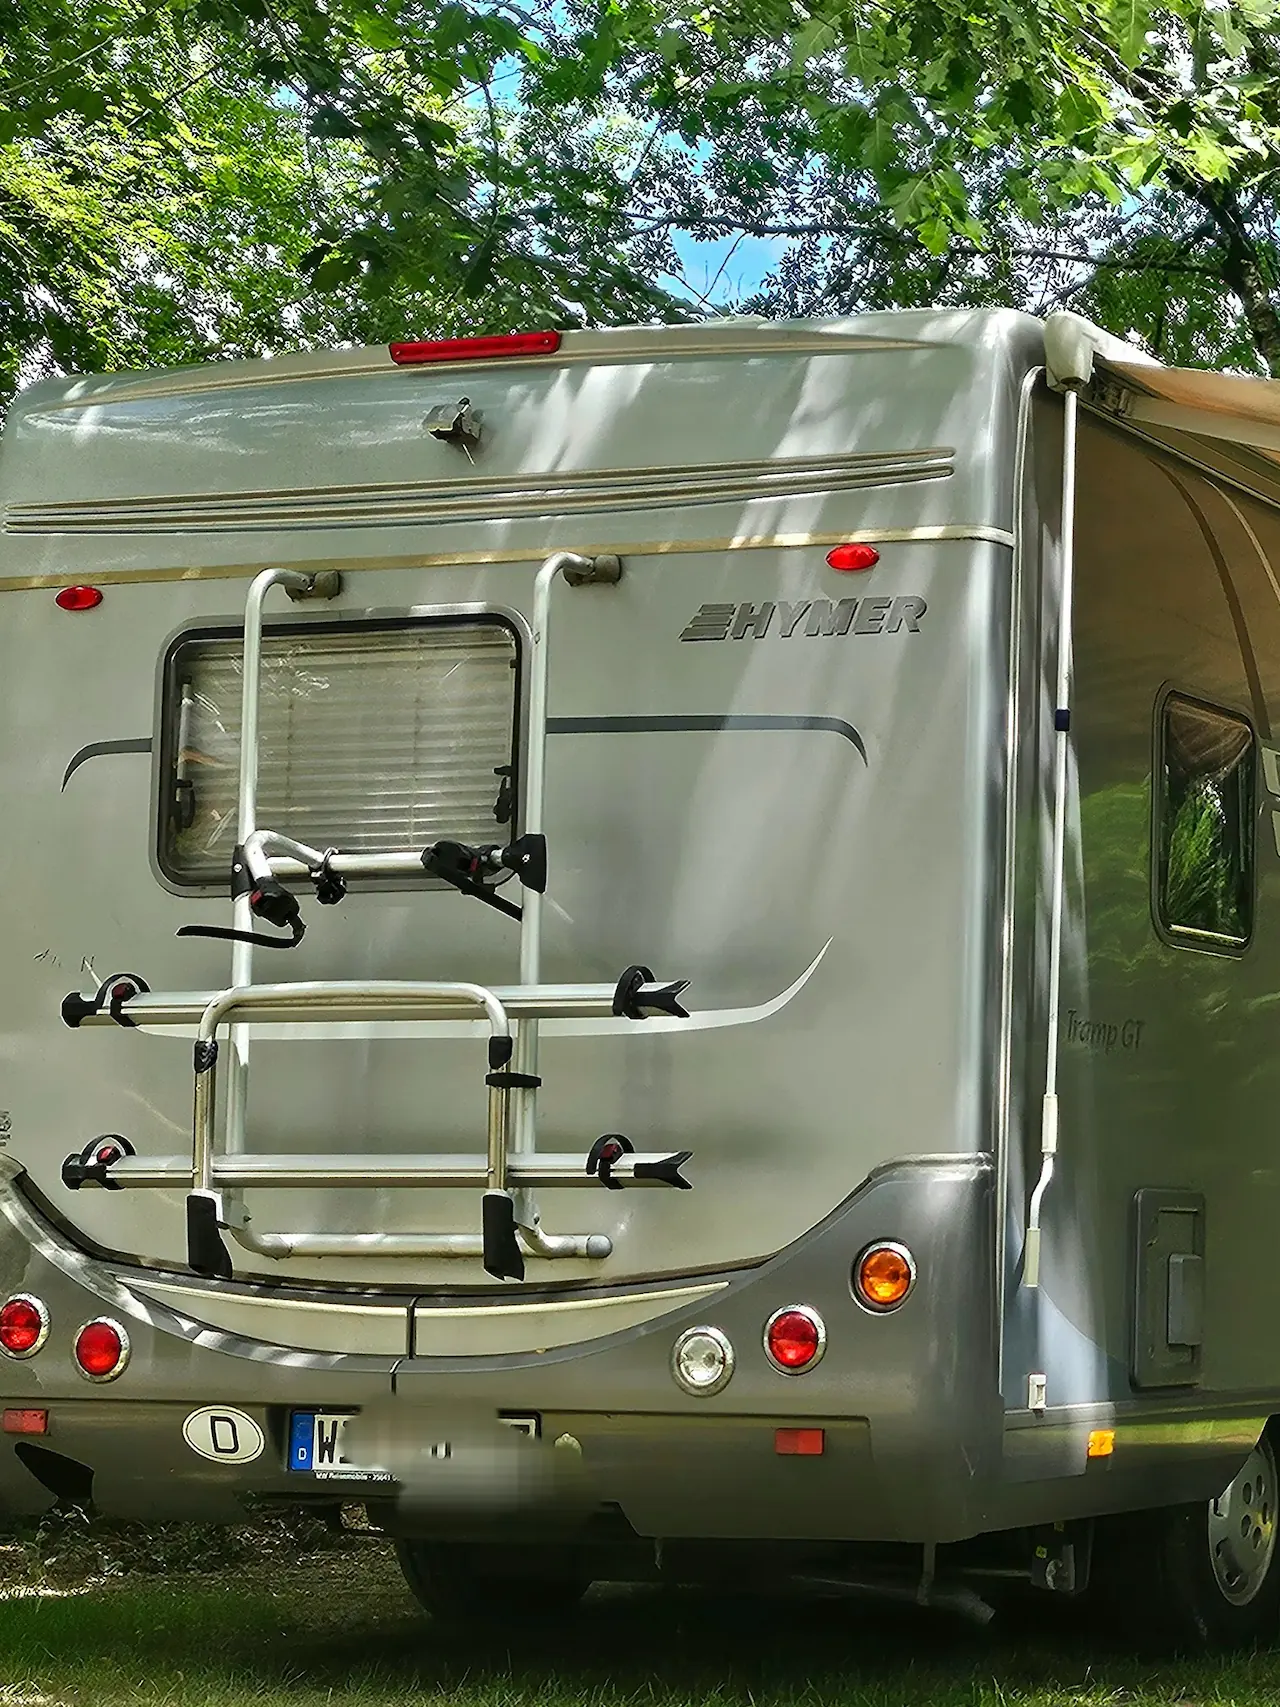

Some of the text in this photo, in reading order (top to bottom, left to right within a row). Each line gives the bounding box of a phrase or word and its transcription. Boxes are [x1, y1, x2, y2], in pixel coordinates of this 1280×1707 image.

[730, 595, 928, 640] HYMER
[1067, 1009, 1147, 1055] Tramp GT
[209, 1415, 240, 1455] D
[298, 1447, 307, 1461] D
